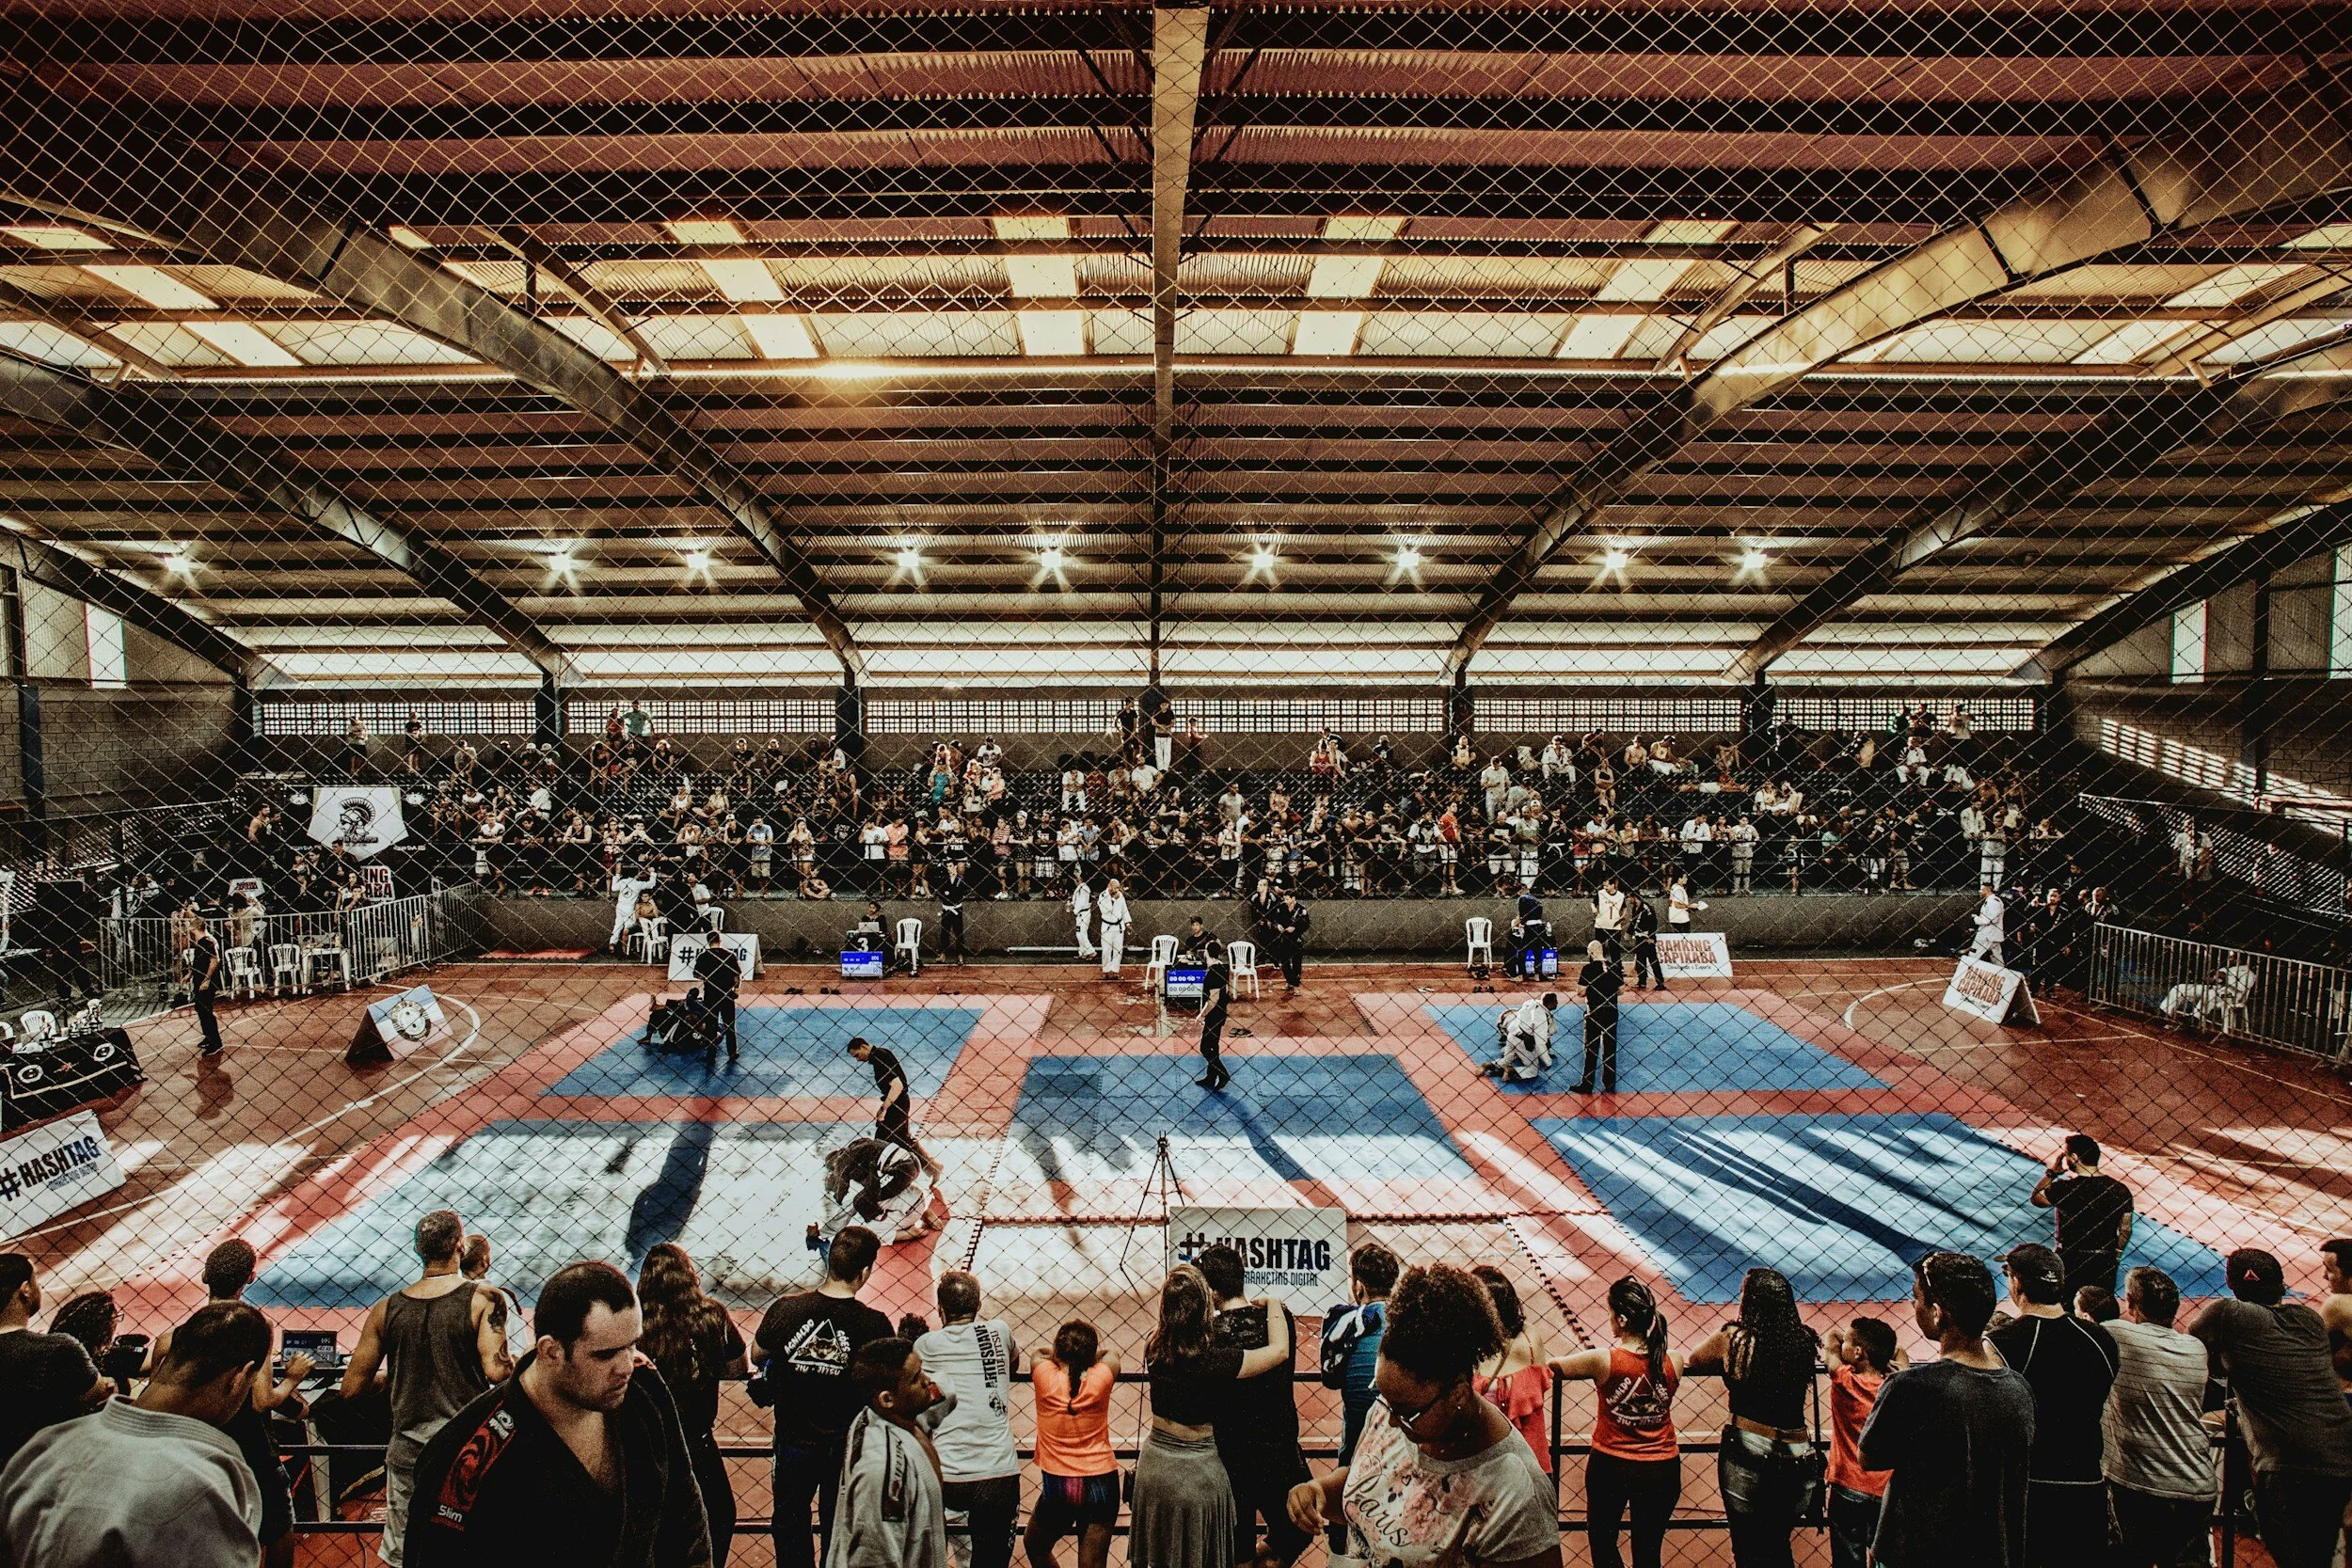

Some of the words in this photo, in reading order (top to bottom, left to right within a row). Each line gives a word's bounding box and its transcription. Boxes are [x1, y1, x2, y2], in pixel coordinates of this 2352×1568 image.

[857, 937, 869, 952] 3
[1657, 940, 1711, 952] RANKING
[1657, 951, 1718, 963] CAPIXABA
[1964, 966, 2006, 990] RANKING
[1957, 978, 2001, 1006] CAPIXABA
[1244, 1271, 1289, 1286] MARKETING
[1290, 1272, 1319, 1287] DIGITAL
[1343, 1453, 1412, 1547] Paris
[437, 1504, 463, 1523] Slim
